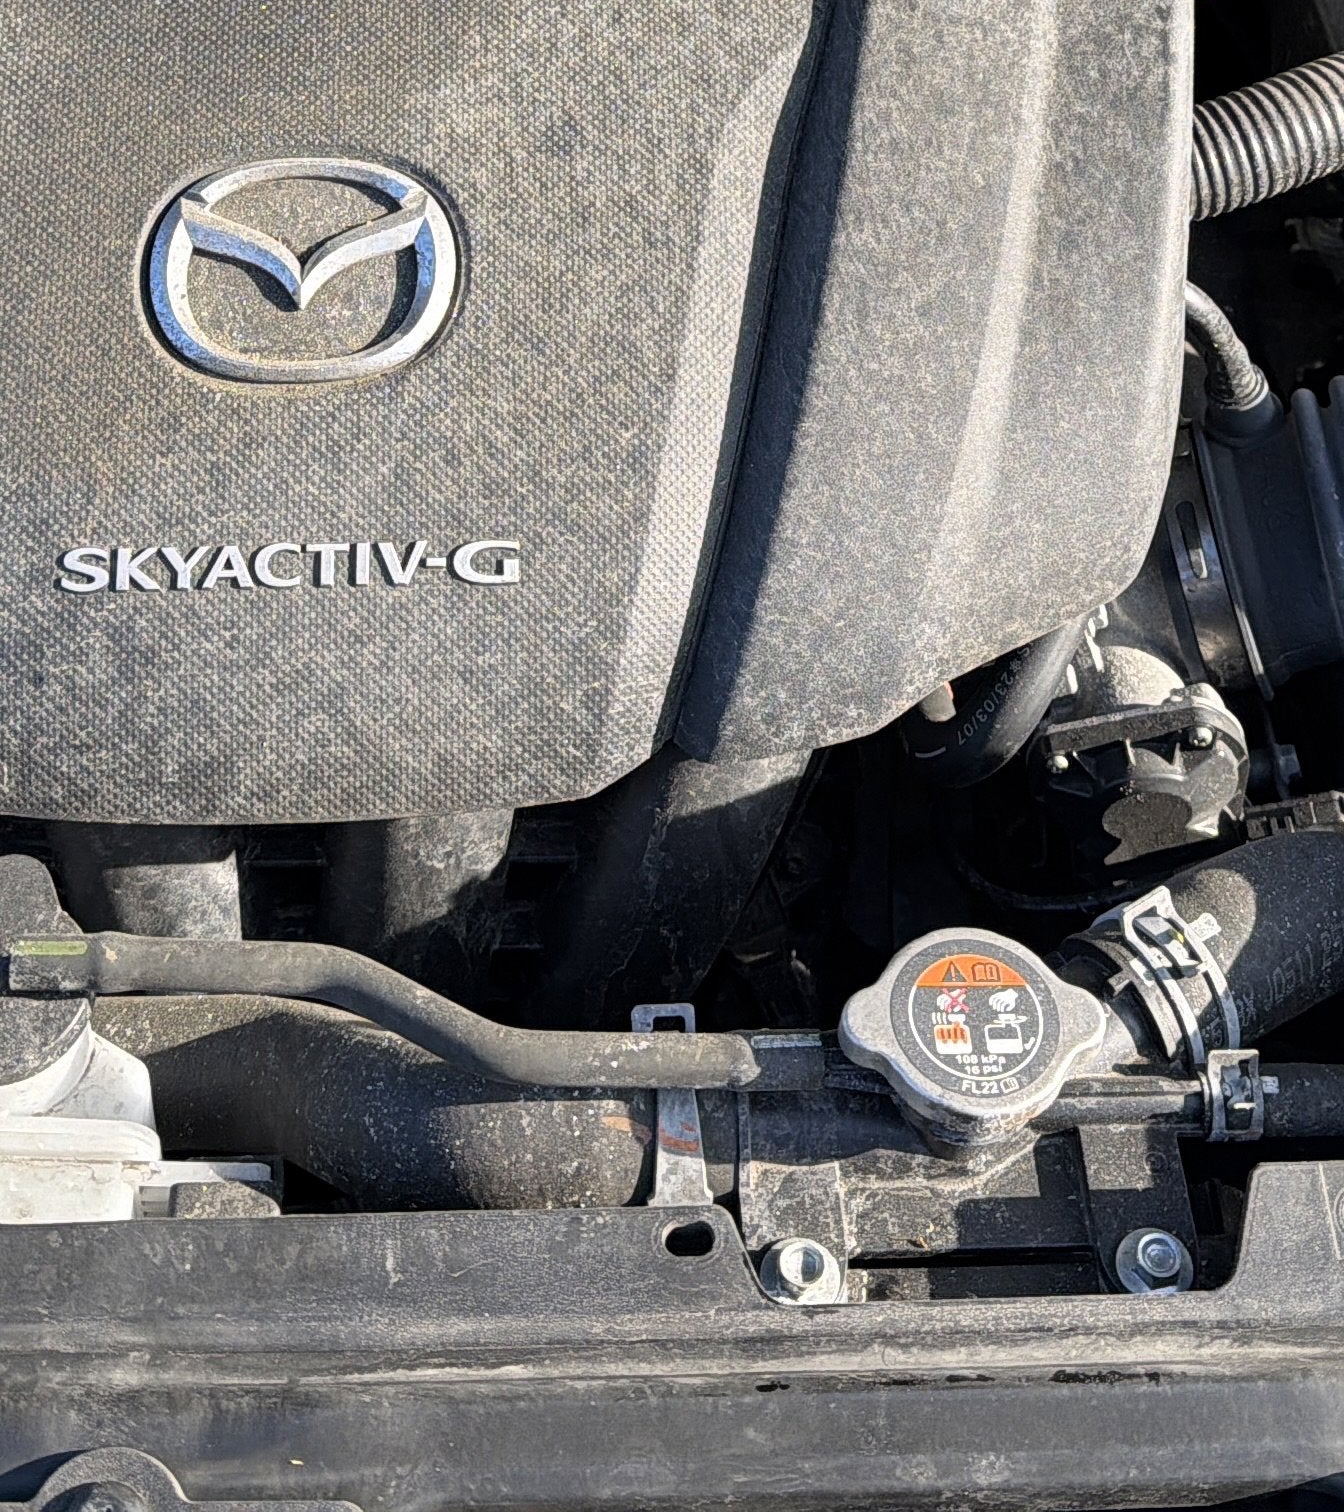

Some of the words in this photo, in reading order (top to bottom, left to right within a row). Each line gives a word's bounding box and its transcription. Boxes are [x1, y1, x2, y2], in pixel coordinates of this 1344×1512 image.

[58, 539, 523, 593] SKYACTIV-G
[955, 1054, 979, 1065] 108
[981, 1054, 1006, 1065] kPa
[964, 1065, 981, 1075] 16
[982, 1064, 1003, 1076] psi
[961, 1079, 1000, 1095] FL22
